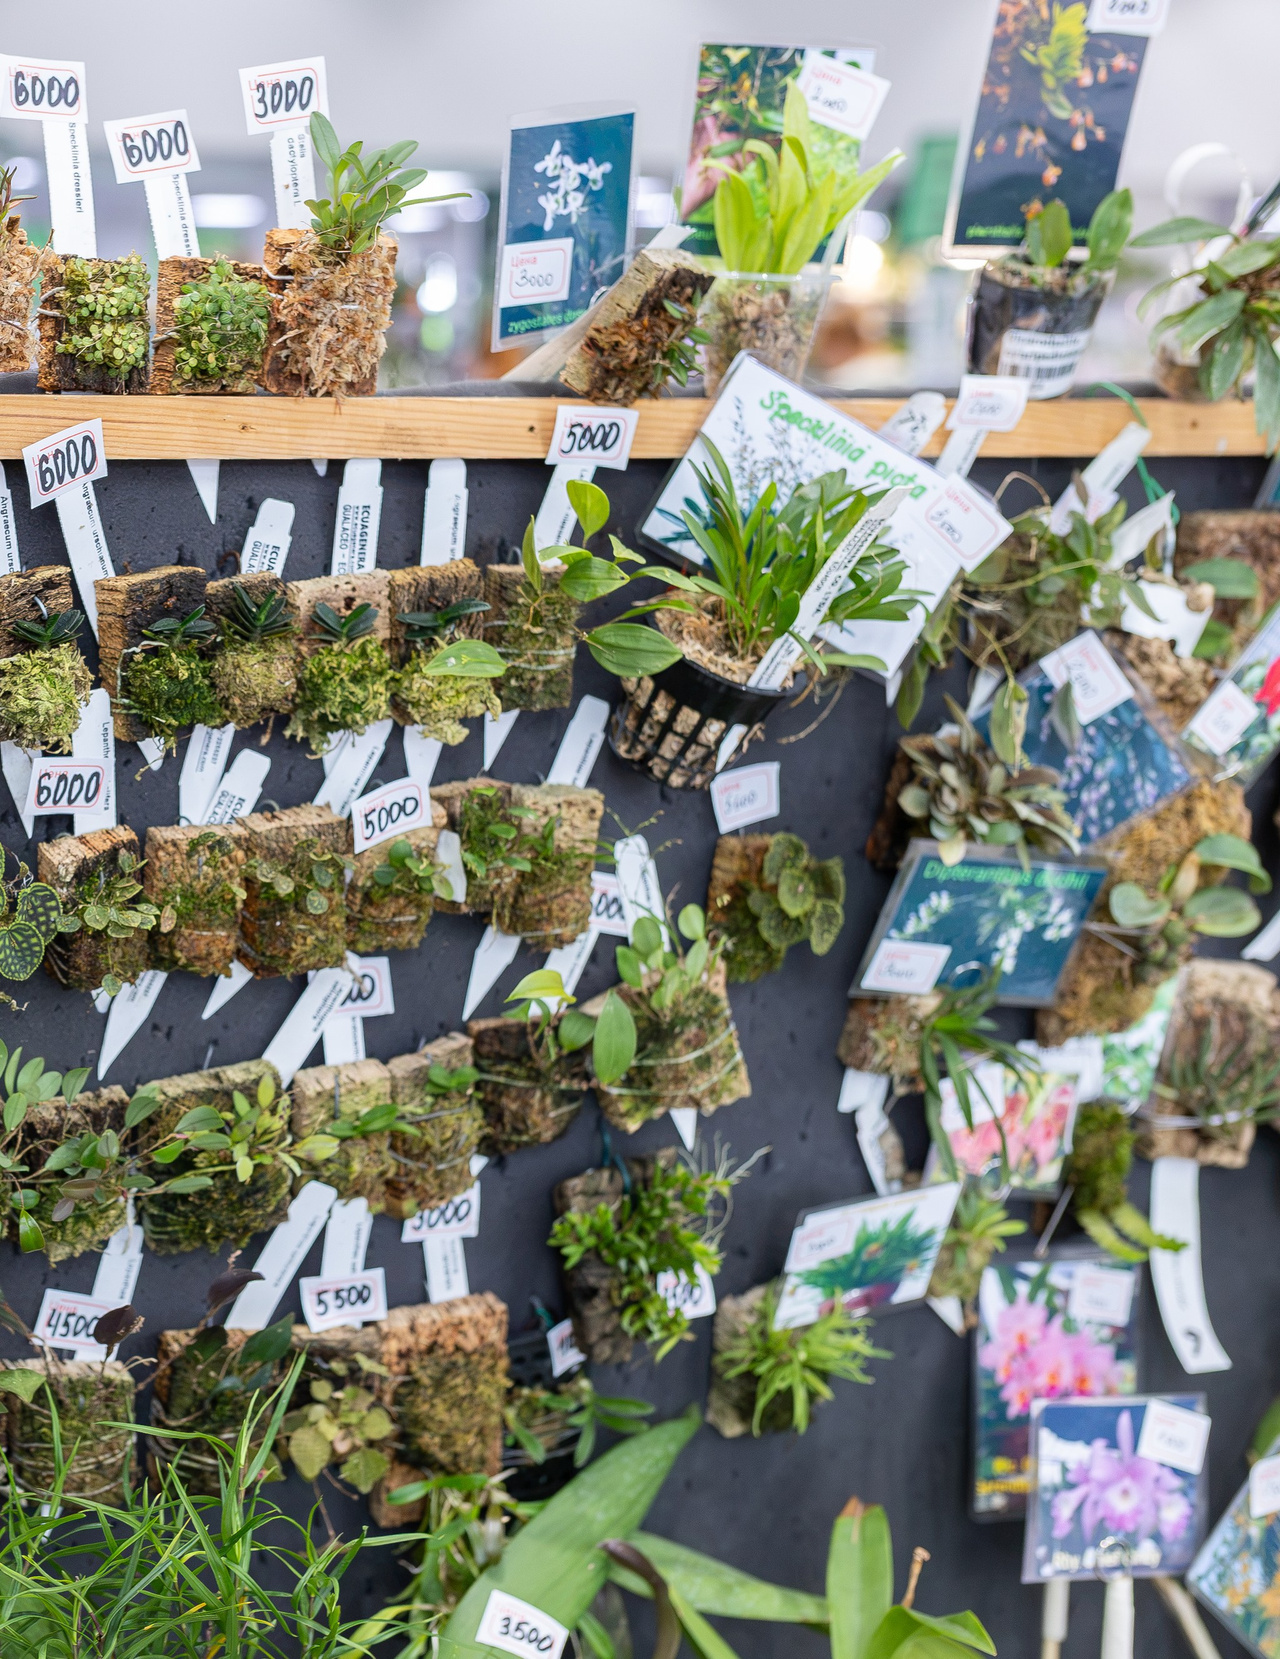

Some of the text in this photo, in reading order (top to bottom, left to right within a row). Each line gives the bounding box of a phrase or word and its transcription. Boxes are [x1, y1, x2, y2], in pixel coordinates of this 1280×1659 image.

[14, 71, 80, 108] 6000
[254, 76, 314, 118] 3000
[69, 122, 79, 170] Specklinia
[122, 120, 189, 167] 6000
[181, 223, 192, 256] dressle
[515, 268, 553, 287] 3000
[561, 422, 620, 453] 5000
[38, 435, 97, 492] 6000
[0, 496, 13, 550] Angraecum
[340, 504, 352, 550] GUALACEO
[357, 505, 371, 570] ECUAGENERA
[36, 771, 101, 806] 6000
[364, 797, 419, 840] 5000
[315, 1283, 372, 1316] 5500
[499, 1616, 555, 1652] 3500
